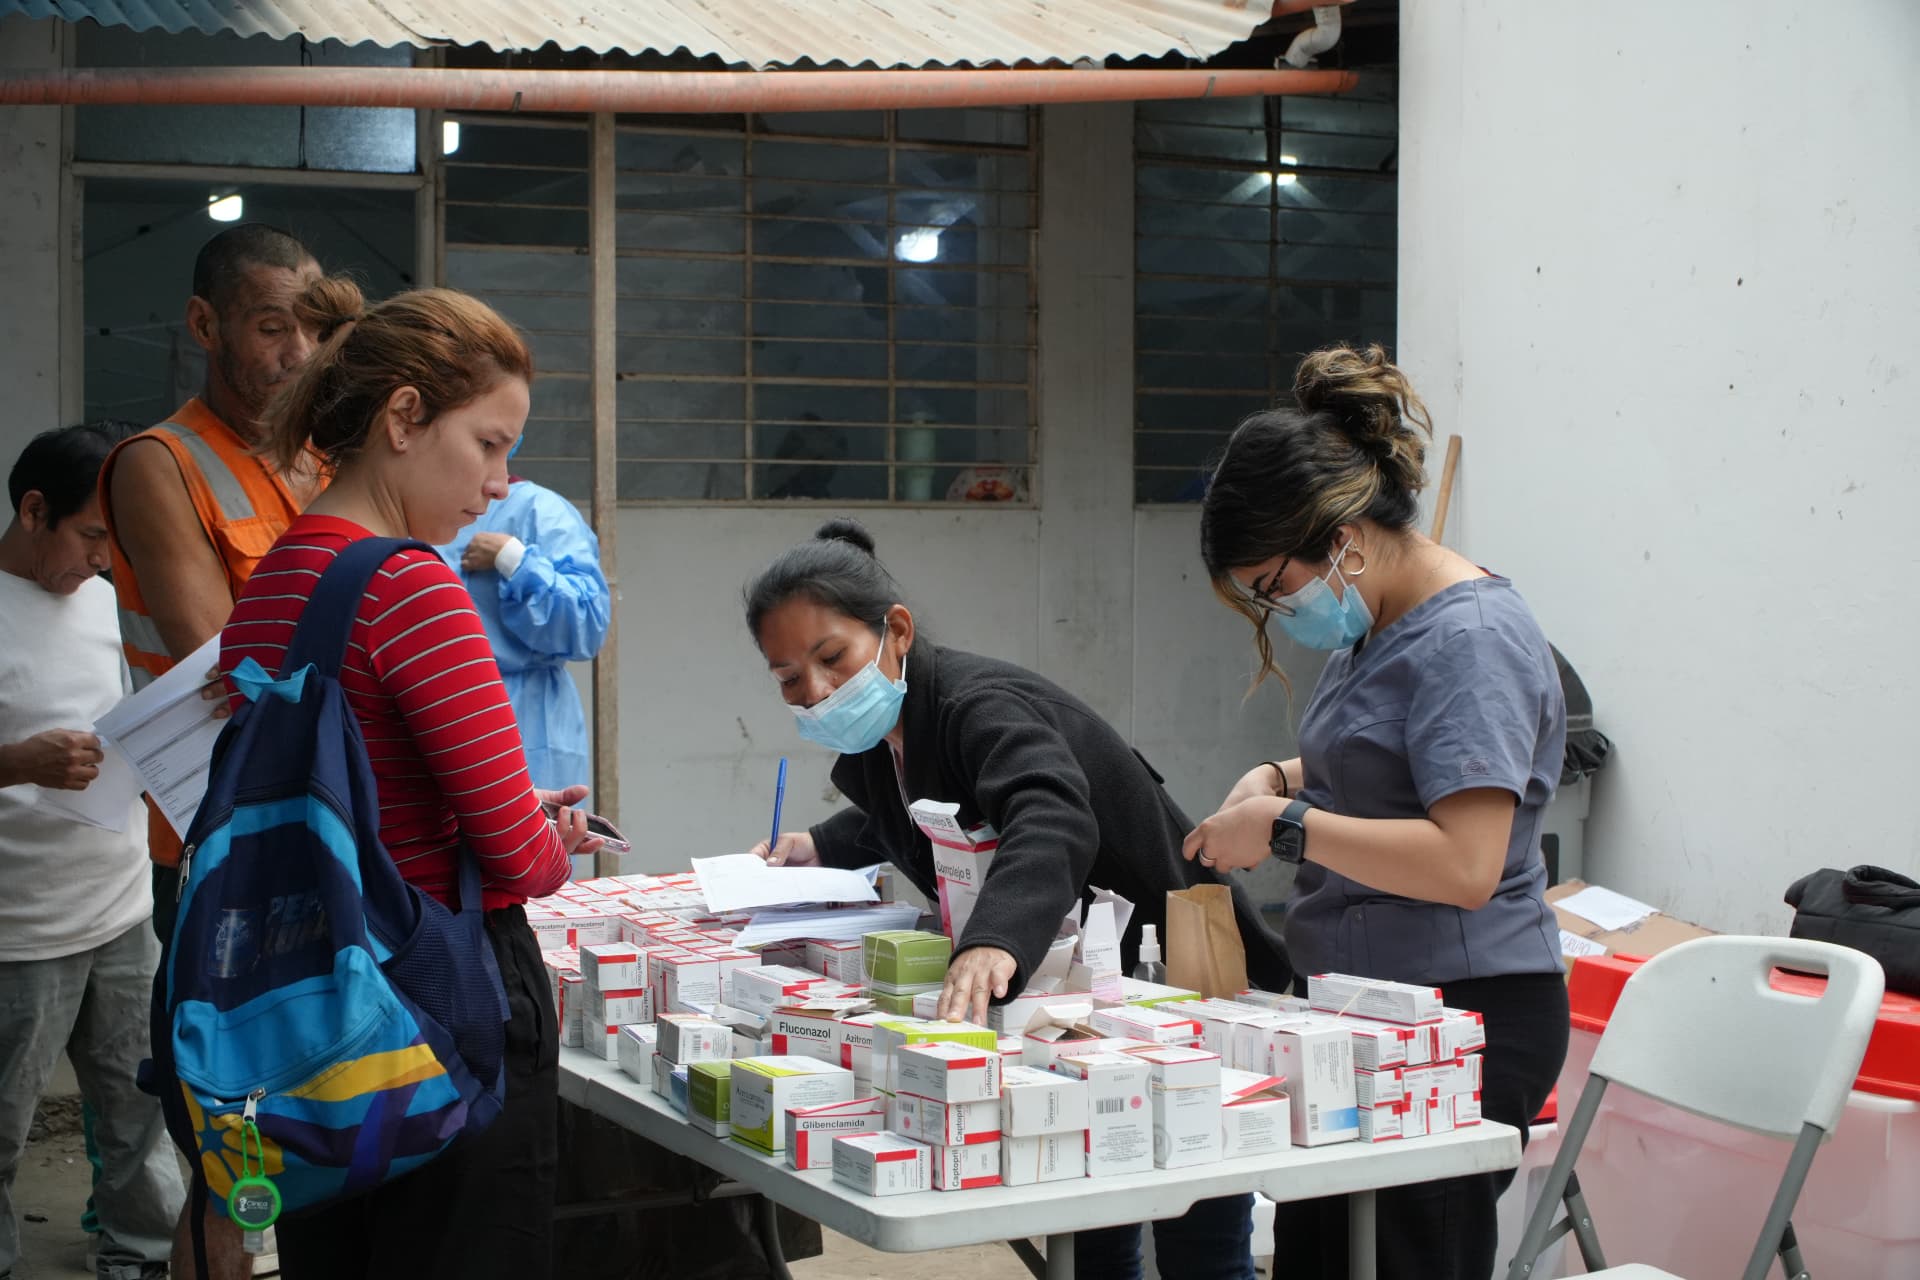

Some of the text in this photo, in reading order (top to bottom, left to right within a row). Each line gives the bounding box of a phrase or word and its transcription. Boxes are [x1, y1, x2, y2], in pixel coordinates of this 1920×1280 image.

[946, 818, 954, 828] B
[965, 867, 972, 880] B
[779, 1021, 831, 1039] Fluconazol
[802, 1119, 865, 1129] Glibenclamida
[955, 1104, 963, 1143] Captopril
